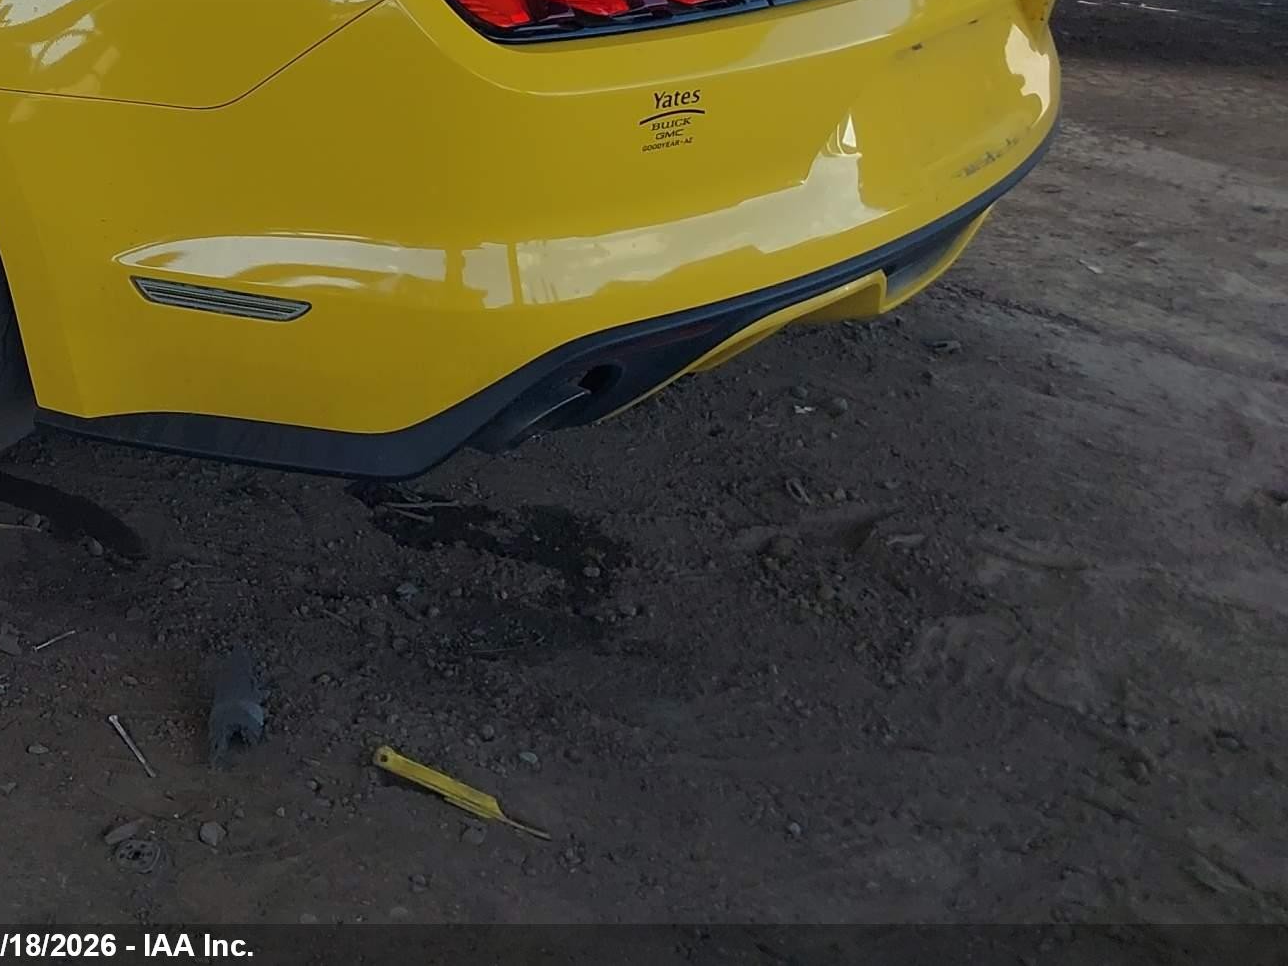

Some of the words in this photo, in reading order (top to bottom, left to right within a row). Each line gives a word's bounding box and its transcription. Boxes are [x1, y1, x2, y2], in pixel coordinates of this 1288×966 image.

[653, 89, 701, 109] Yates
[652, 117, 691, 131] BUICK
[655, 129, 685, 140] GMC
